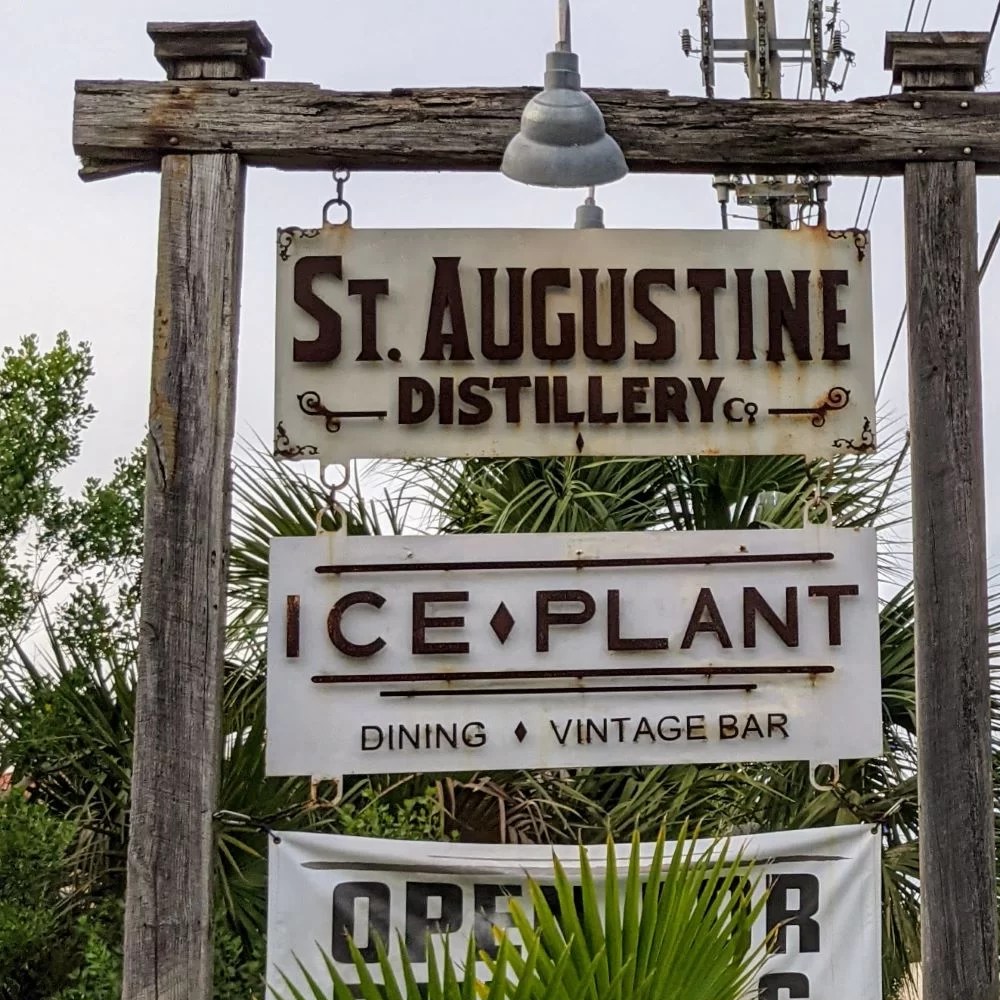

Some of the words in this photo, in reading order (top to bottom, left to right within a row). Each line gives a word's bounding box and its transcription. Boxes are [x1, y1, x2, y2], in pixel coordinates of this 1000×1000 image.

[397, 376, 725, 425] DISTILLERY
[286, 591, 470, 658] ICE
[536, 585, 859, 652] PLANT
[361, 721, 487, 751] DINING
[549, 715, 707, 746] VINTAGE
[719, 713, 790, 742] BAR
